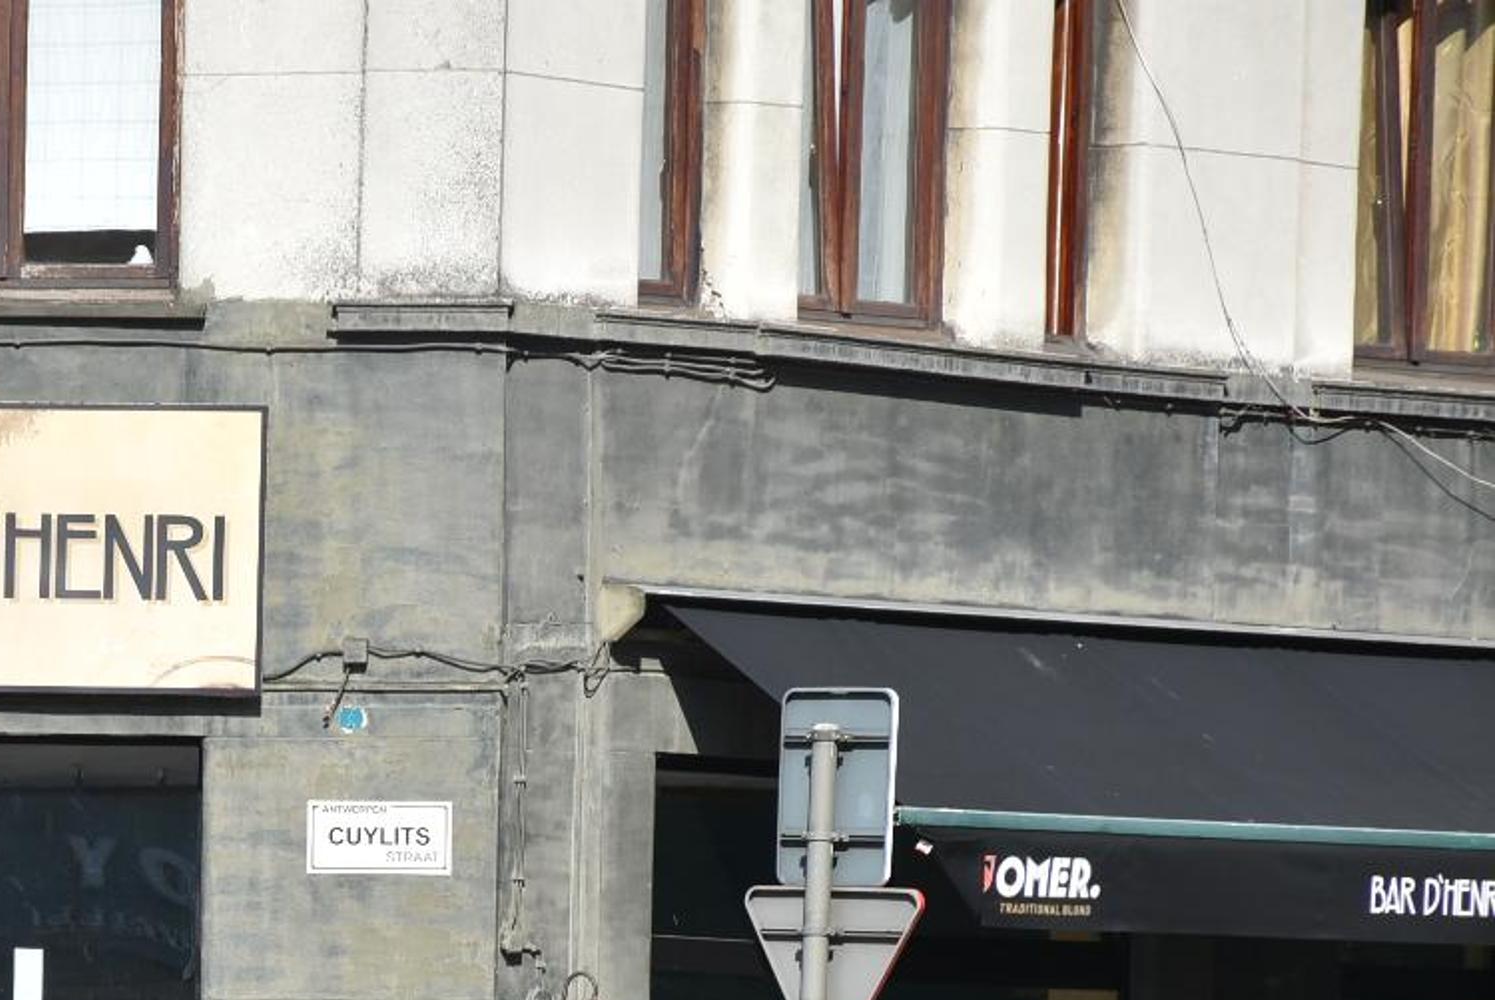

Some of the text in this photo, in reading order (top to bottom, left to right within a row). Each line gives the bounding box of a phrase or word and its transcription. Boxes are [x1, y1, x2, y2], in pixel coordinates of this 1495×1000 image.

[328, 826, 431, 846] CUYLITS
[385, 851, 438, 863] STRAAT
[995, 855, 1101, 899] OMER.
[1370, 875, 1416, 915] BAR
